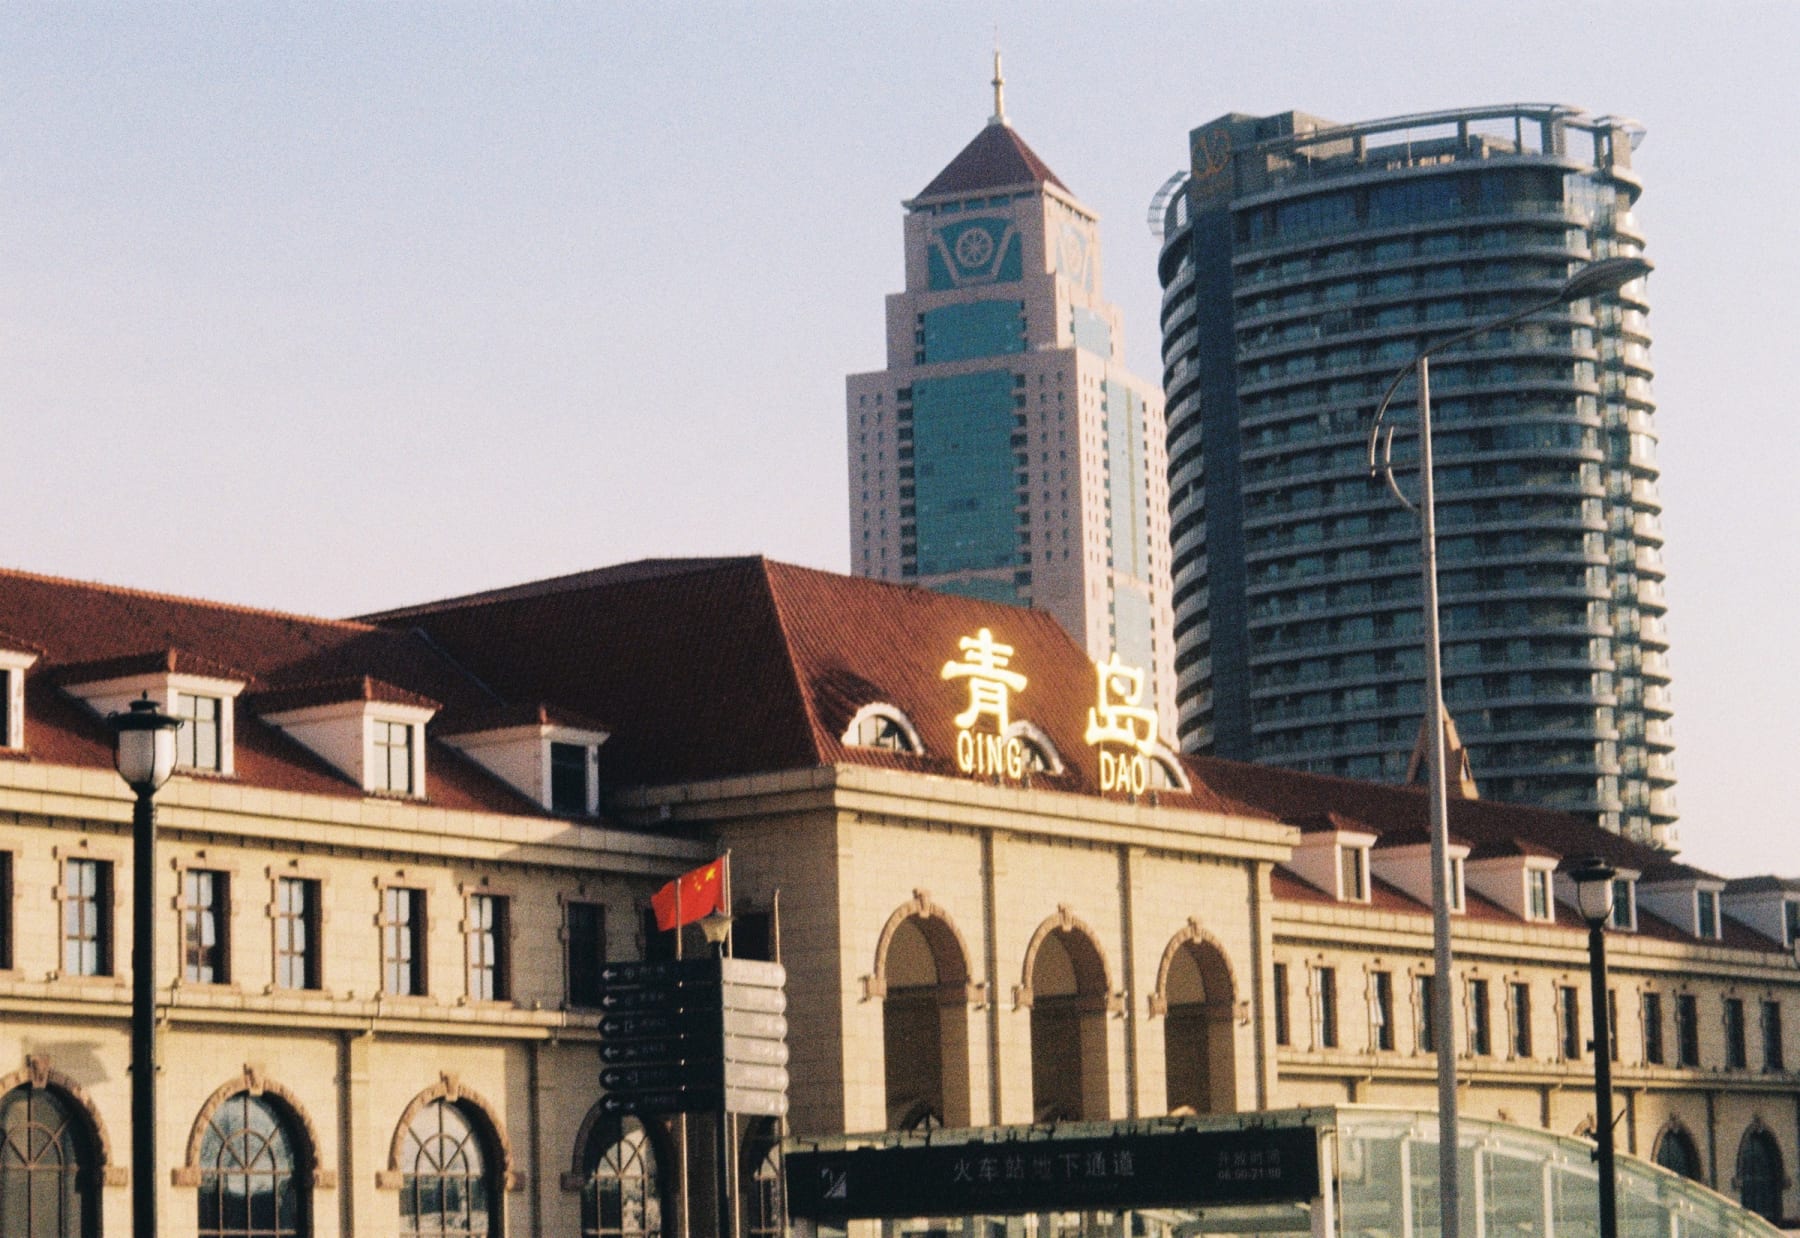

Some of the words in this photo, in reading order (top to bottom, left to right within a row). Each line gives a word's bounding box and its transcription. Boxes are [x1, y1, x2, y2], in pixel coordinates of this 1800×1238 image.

[941, 628, 1158, 757] 青岛
[957, 729, 1022, 779] QING
[1099, 751, 1146, 795] DAO
[953, 1150, 1135, 1182] 火车站地下通道
